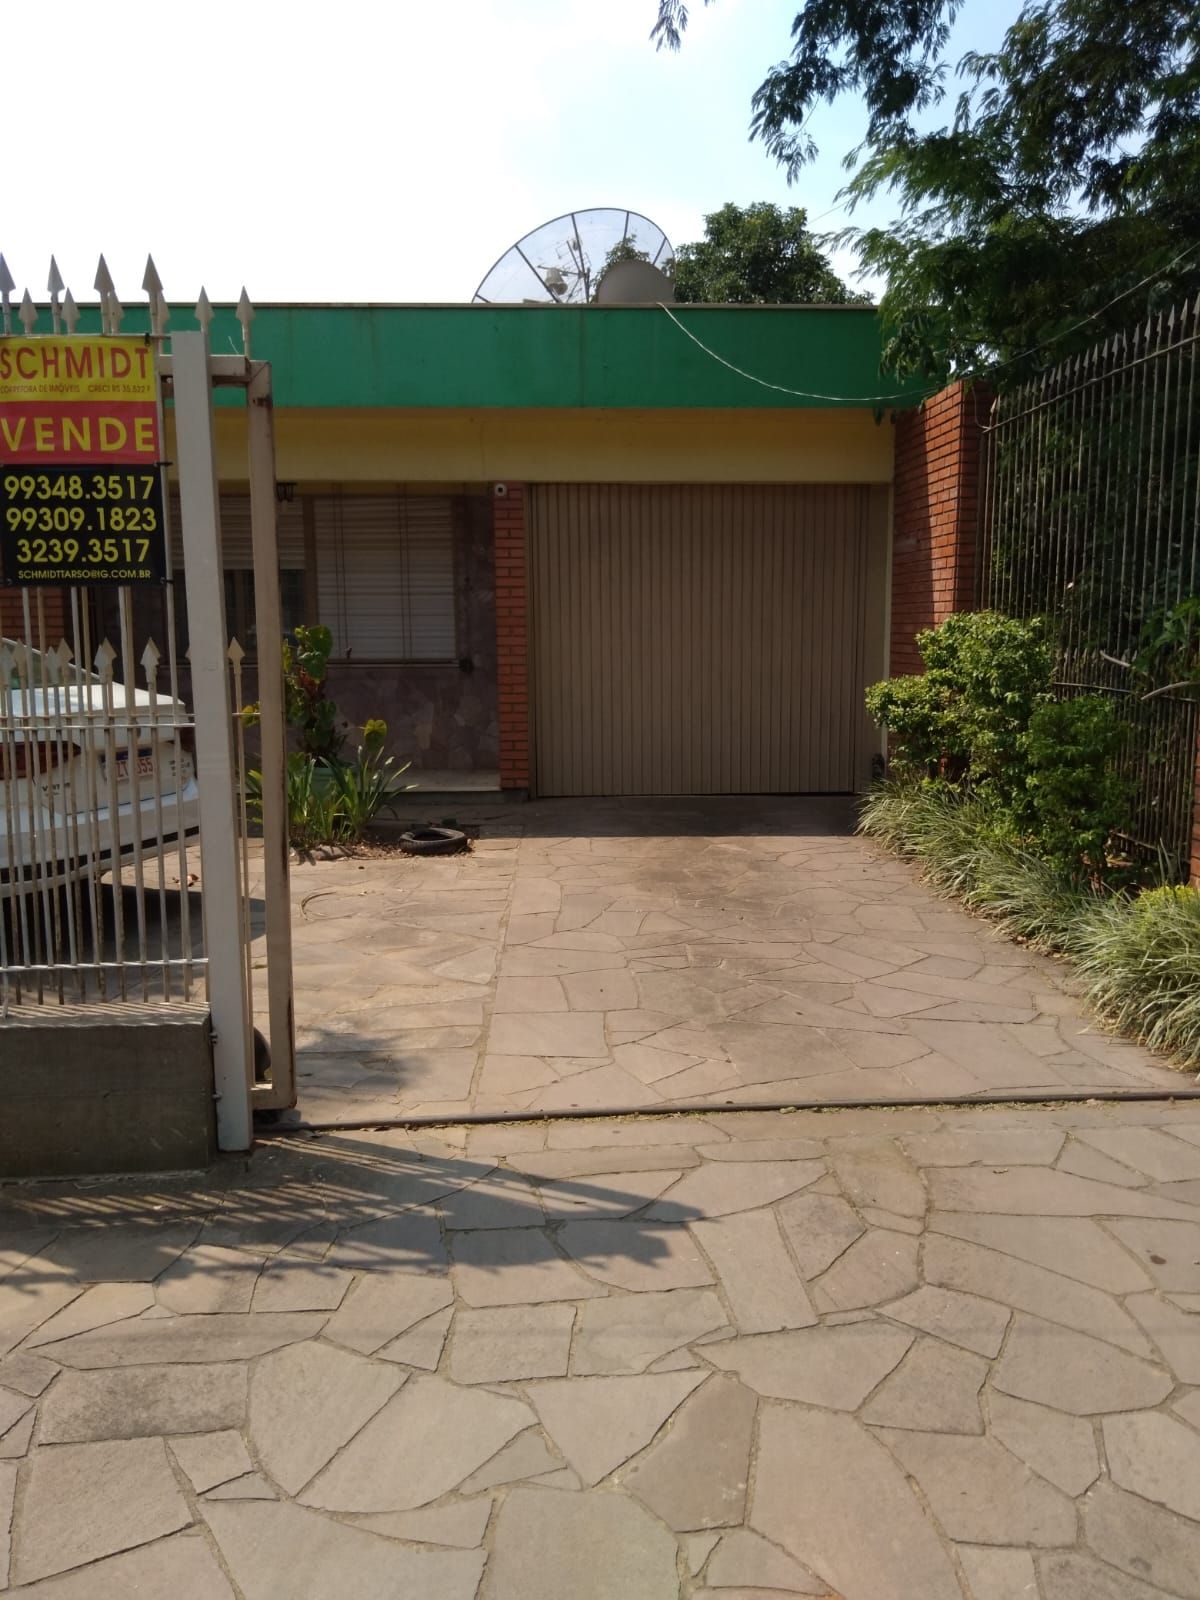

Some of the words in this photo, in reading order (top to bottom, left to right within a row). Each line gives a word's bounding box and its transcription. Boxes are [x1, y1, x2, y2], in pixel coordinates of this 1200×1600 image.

[0, 346, 149, 379] SCHMIDT
[39, 384, 48, 392] DE
[49, 382, 80, 392] IMÓVEIS
[88, 384, 110, 392] CRECI
[0, 416, 155, 452] VENDE
[4, 475, 154, 500] 99348.3517
[6, 506, 157, 531] 99309.1823
[16, 538, 150, 563] 3239.3517
[18, 569, 151, 580] SCHMIDTTARSO@IG.COM.BR
